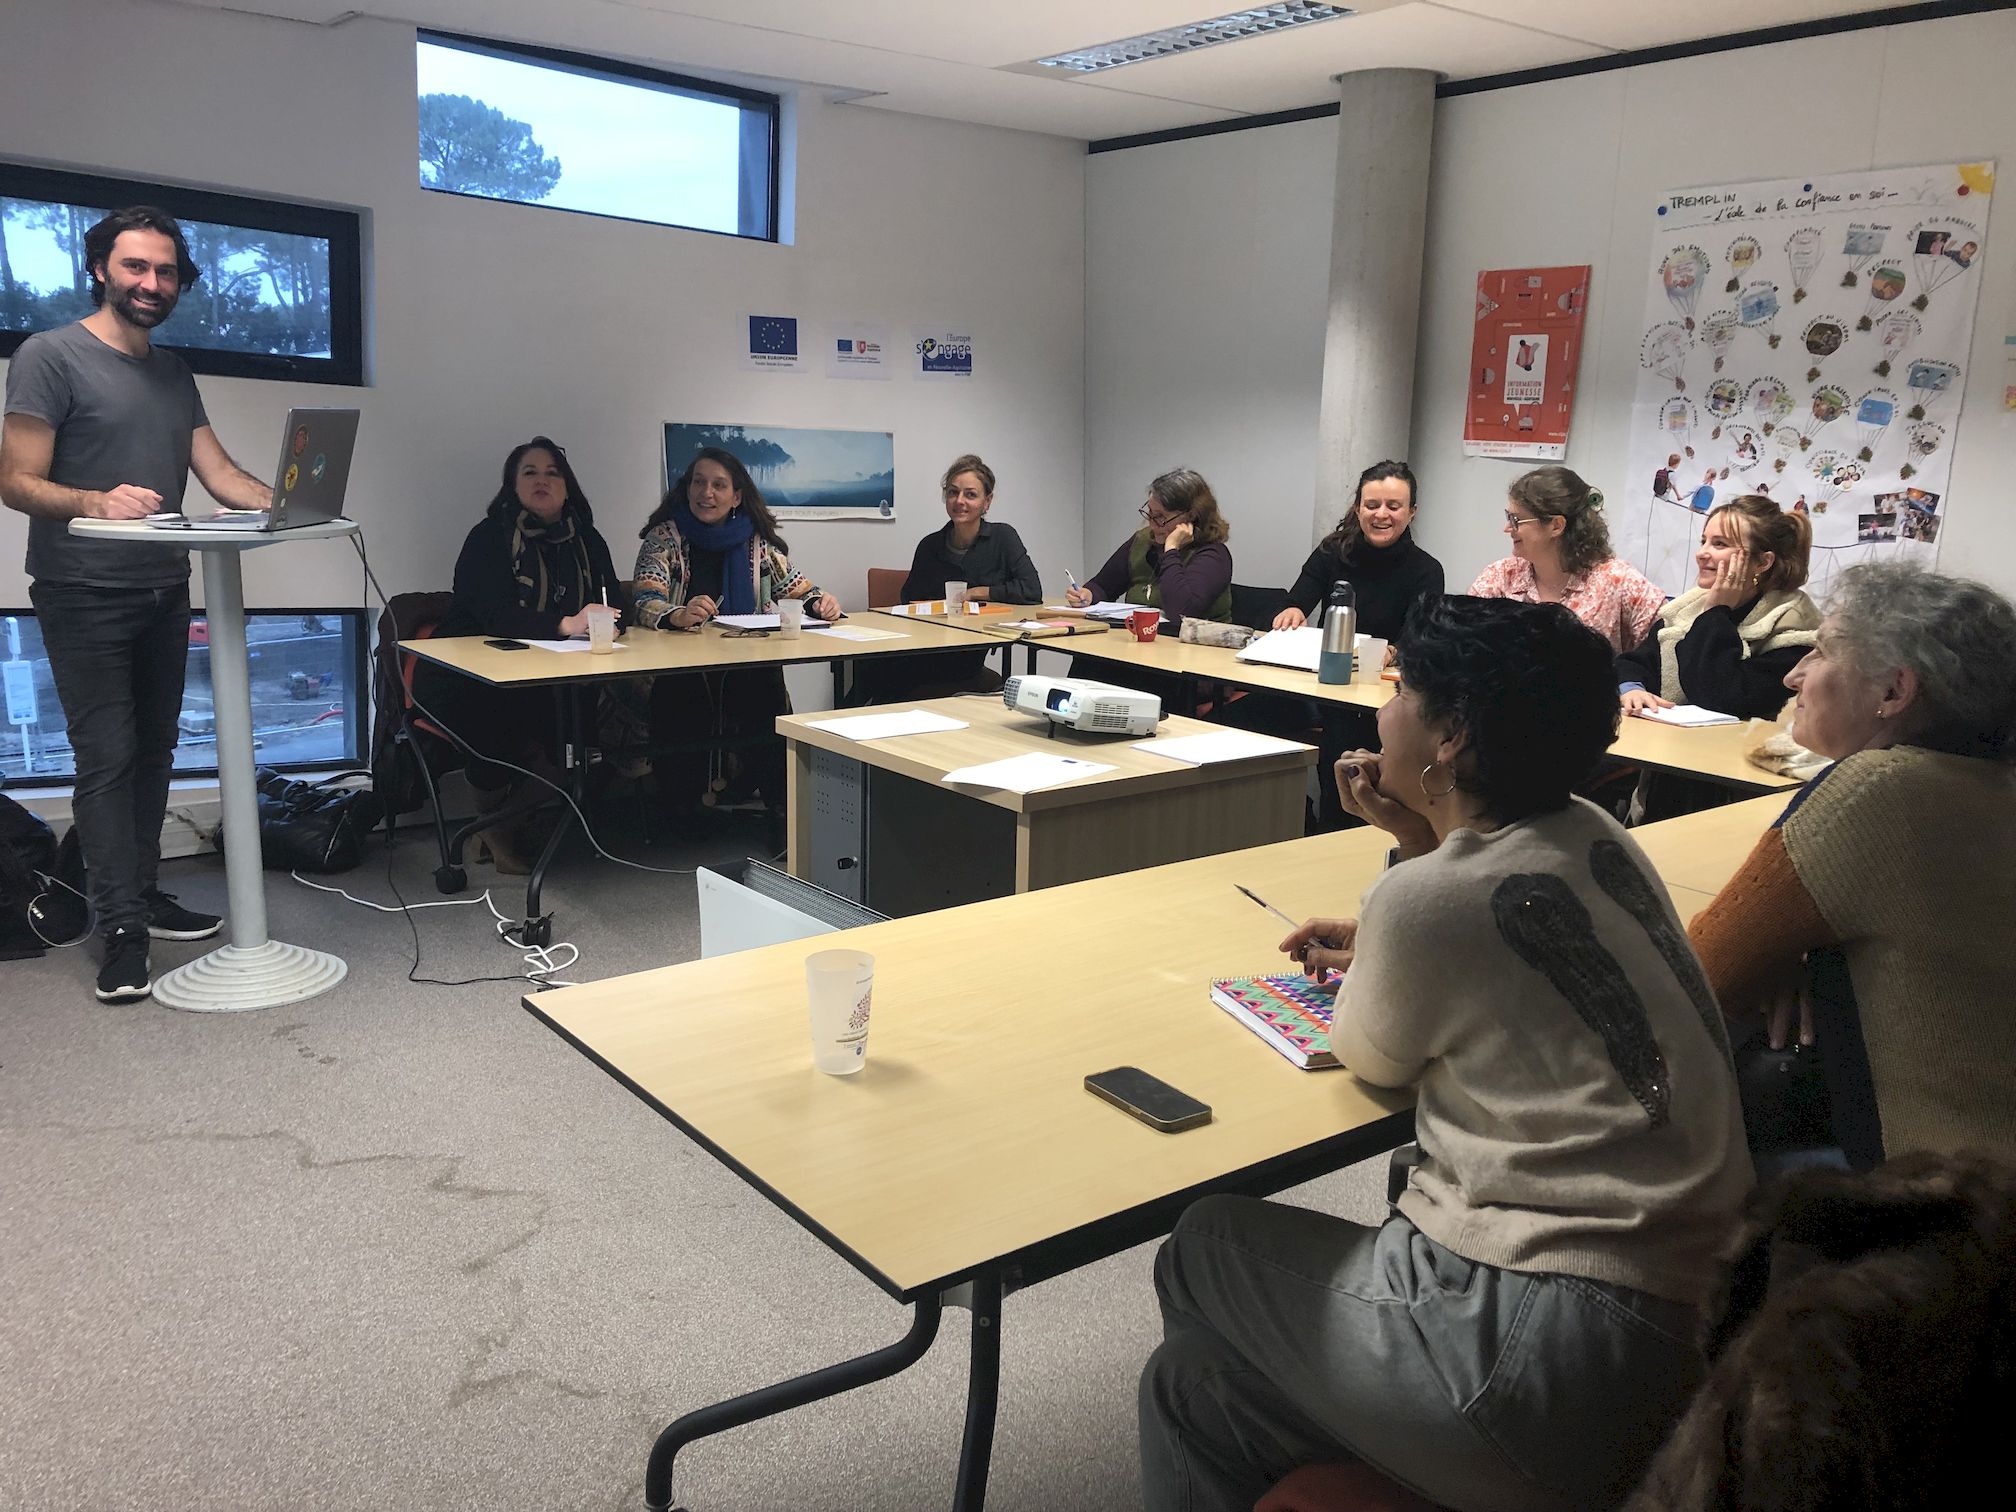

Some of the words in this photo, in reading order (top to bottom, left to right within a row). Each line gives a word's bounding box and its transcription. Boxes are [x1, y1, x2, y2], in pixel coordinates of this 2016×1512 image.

[1669, 193, 1736, 208] TREMPLIN
[1776, 199, 1788, 211] la
[1795, 191, 1841, 211] confiance
[1849, 192, 1861, 201] en
[1506, 388, 1542, 396] JEUNESSE
